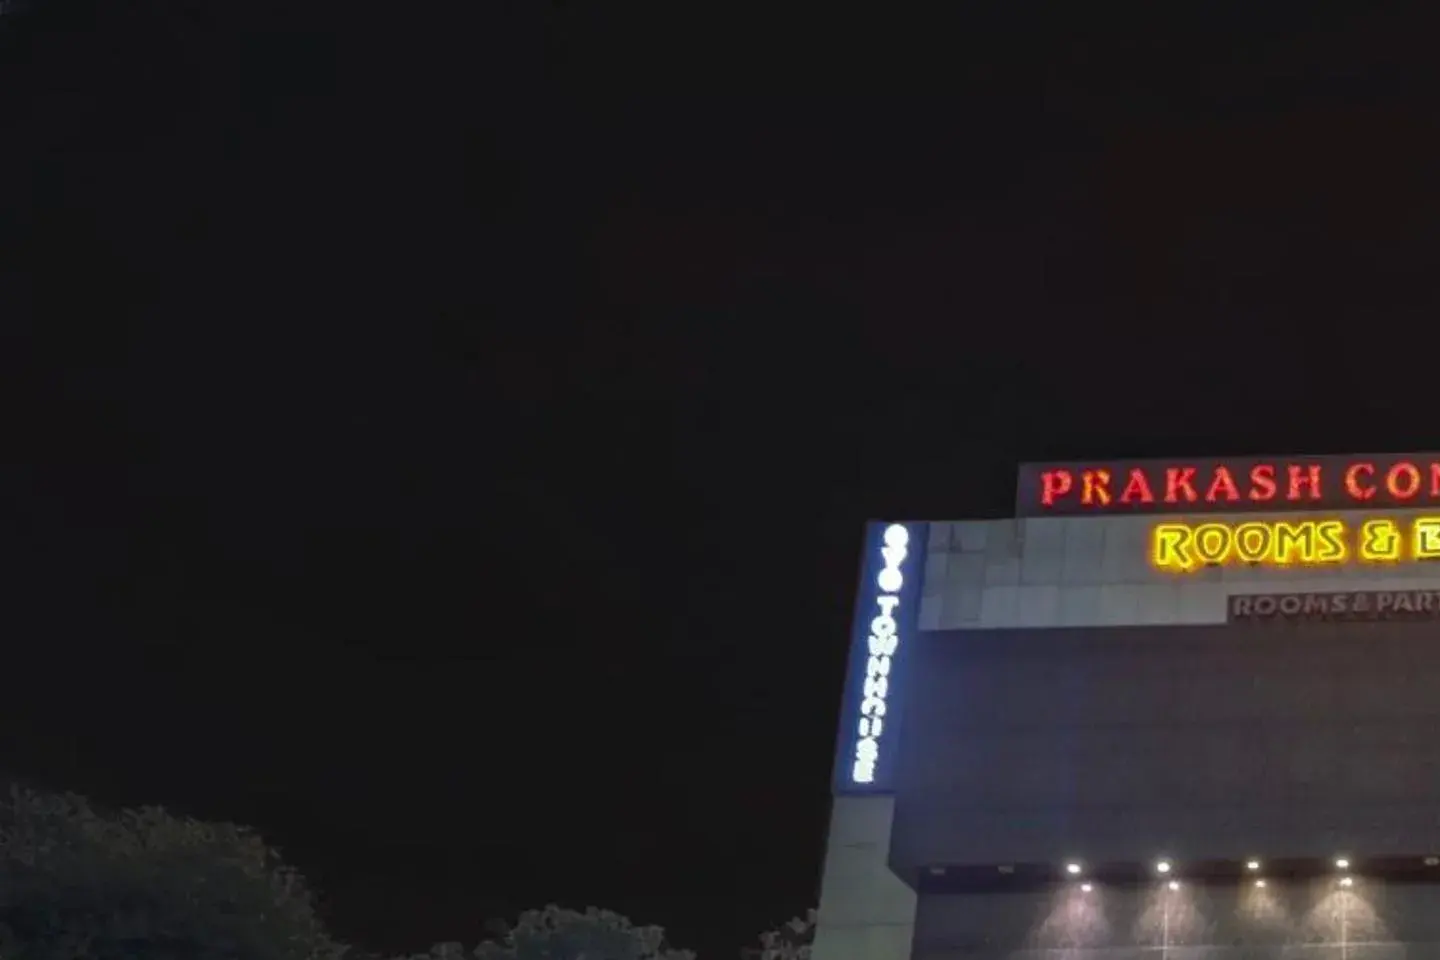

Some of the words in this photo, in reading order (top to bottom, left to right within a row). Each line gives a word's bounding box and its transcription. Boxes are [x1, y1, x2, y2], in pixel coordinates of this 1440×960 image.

[1040, 463, 1323, 505] PRAKASH
[1153, 520, 1346, 569] ROOMS
[1361, 519, 1402, 561] &
